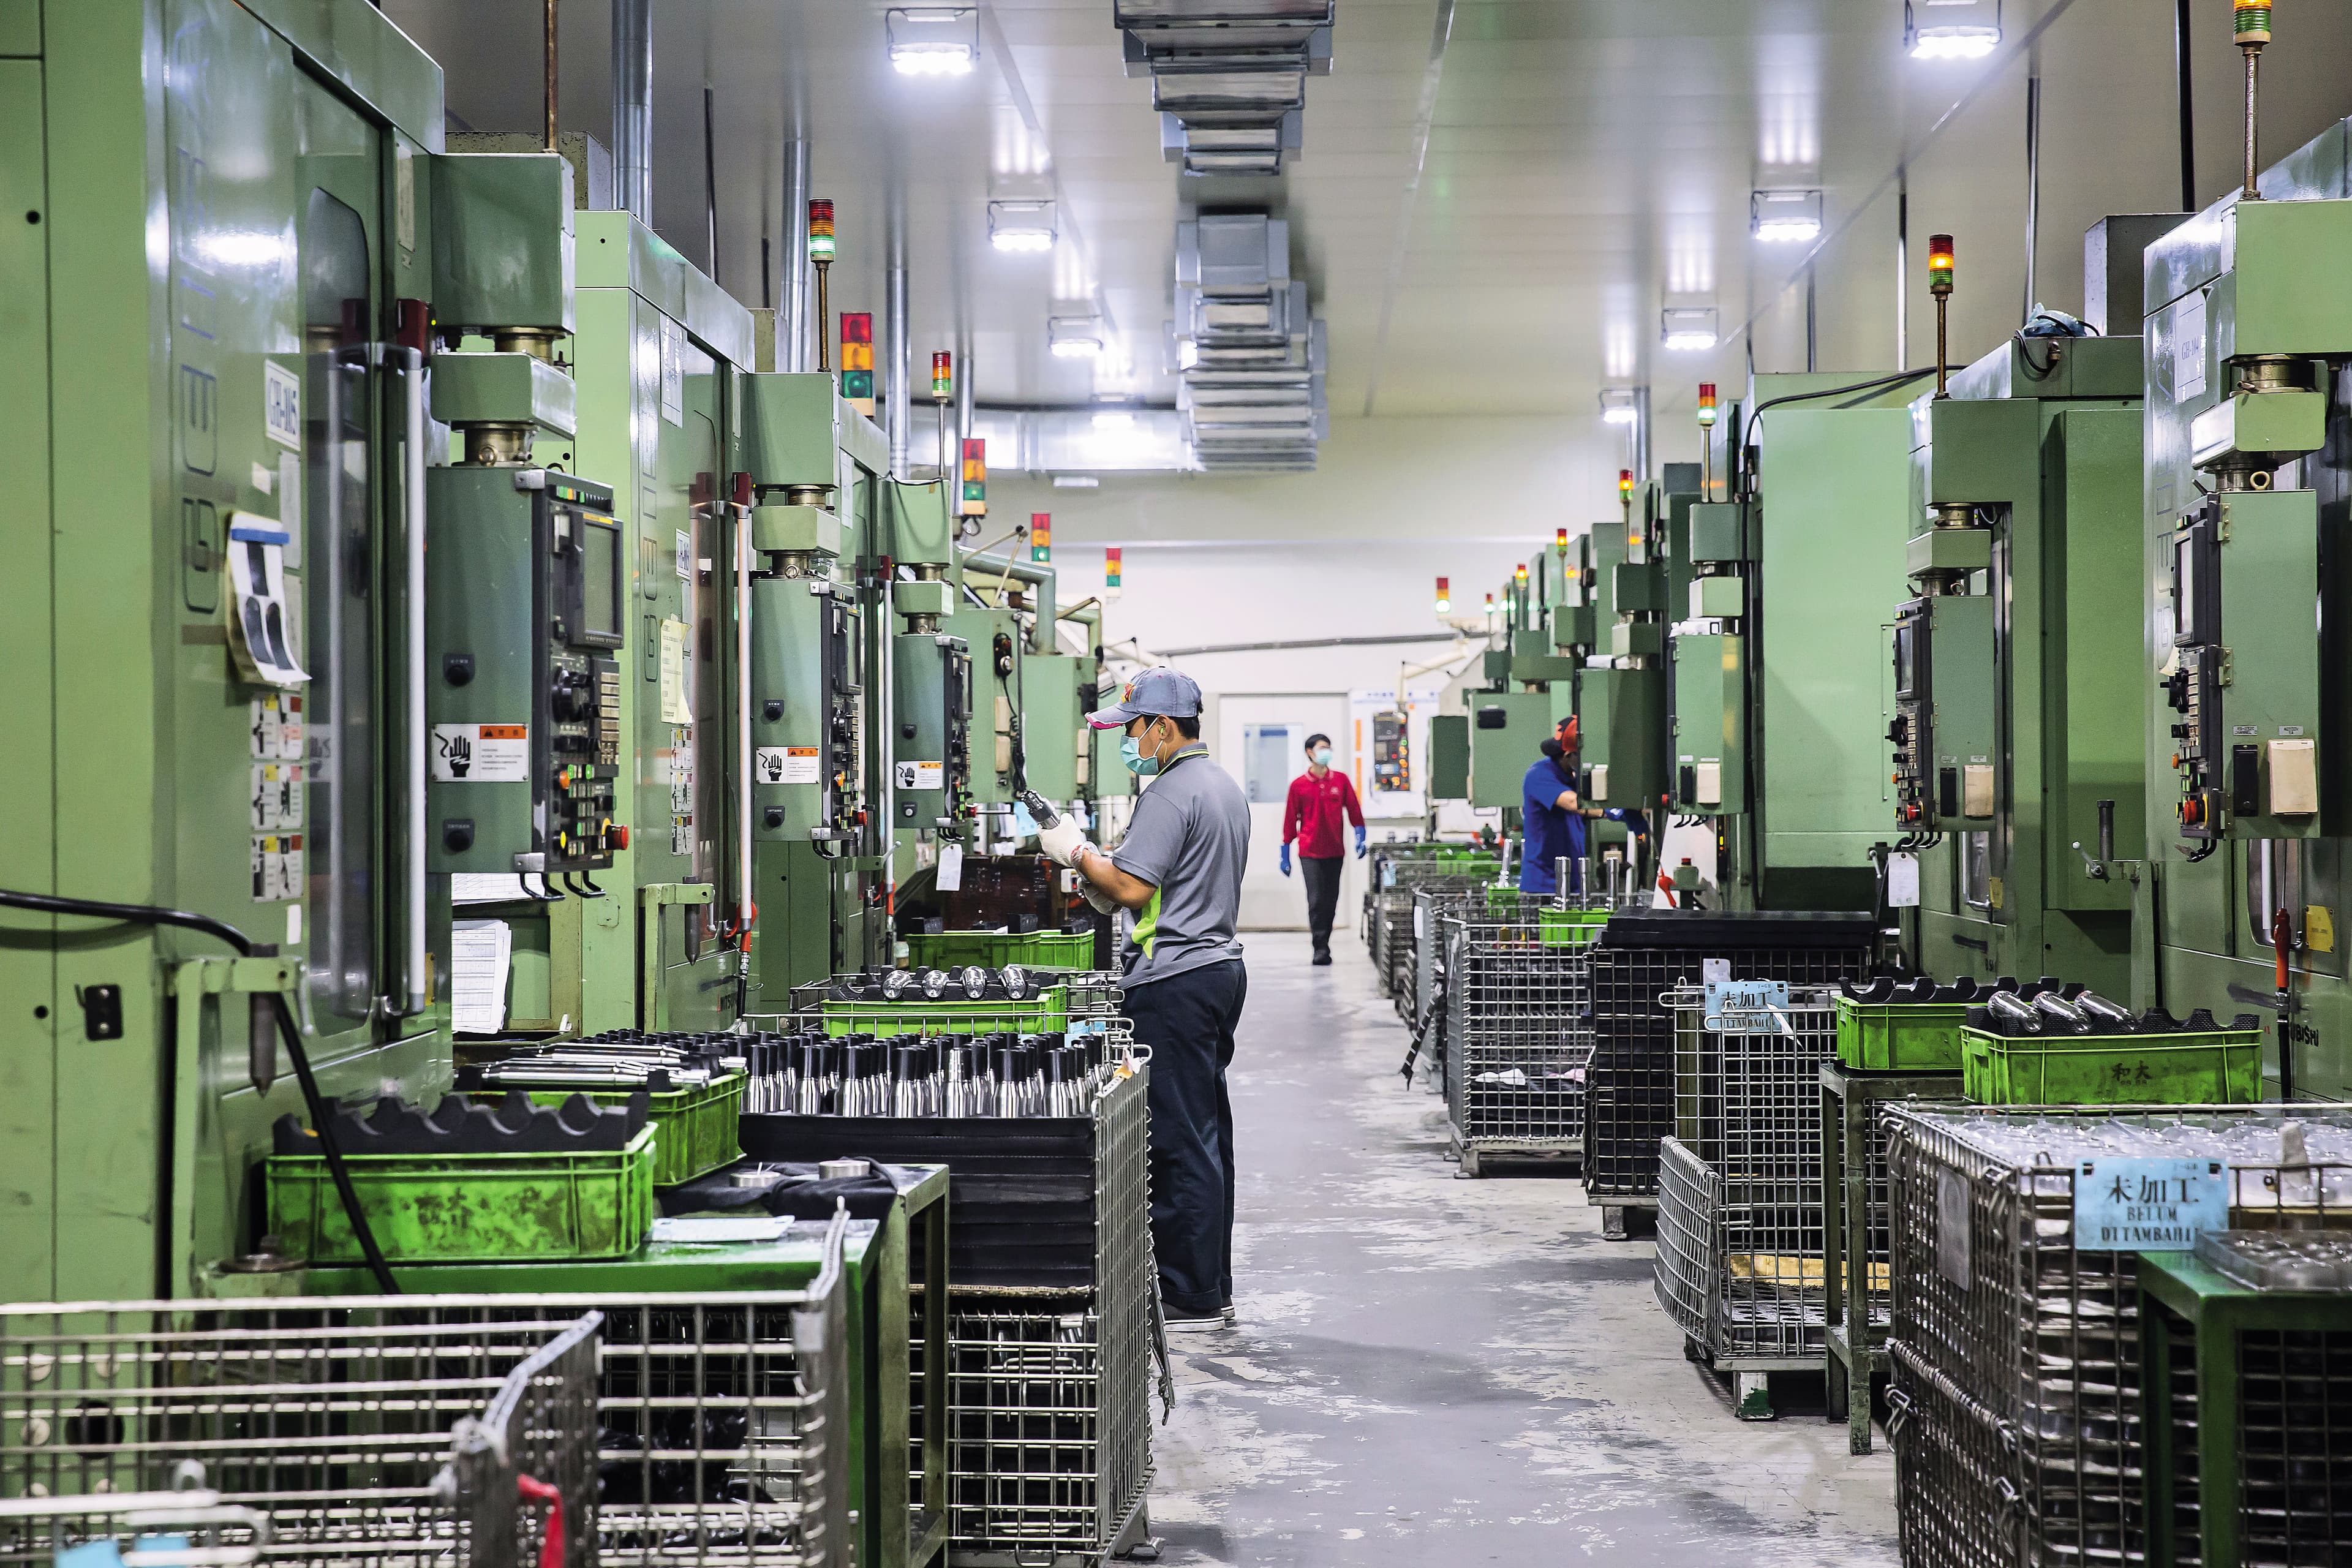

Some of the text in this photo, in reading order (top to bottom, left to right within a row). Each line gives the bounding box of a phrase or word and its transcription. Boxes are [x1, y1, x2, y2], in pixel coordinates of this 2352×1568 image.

[2182, 336, 2199, 360] GH-104
[1721, 991, 1772, 1007] 未加工
[2291, 1023, 2320, 1047] UBISHI
[2111, 1060, 2153, 1082] 和大
[2105, 1174, 2199, 1204] 未加工
[2127, 1205, 2177, 1221] BELUM
